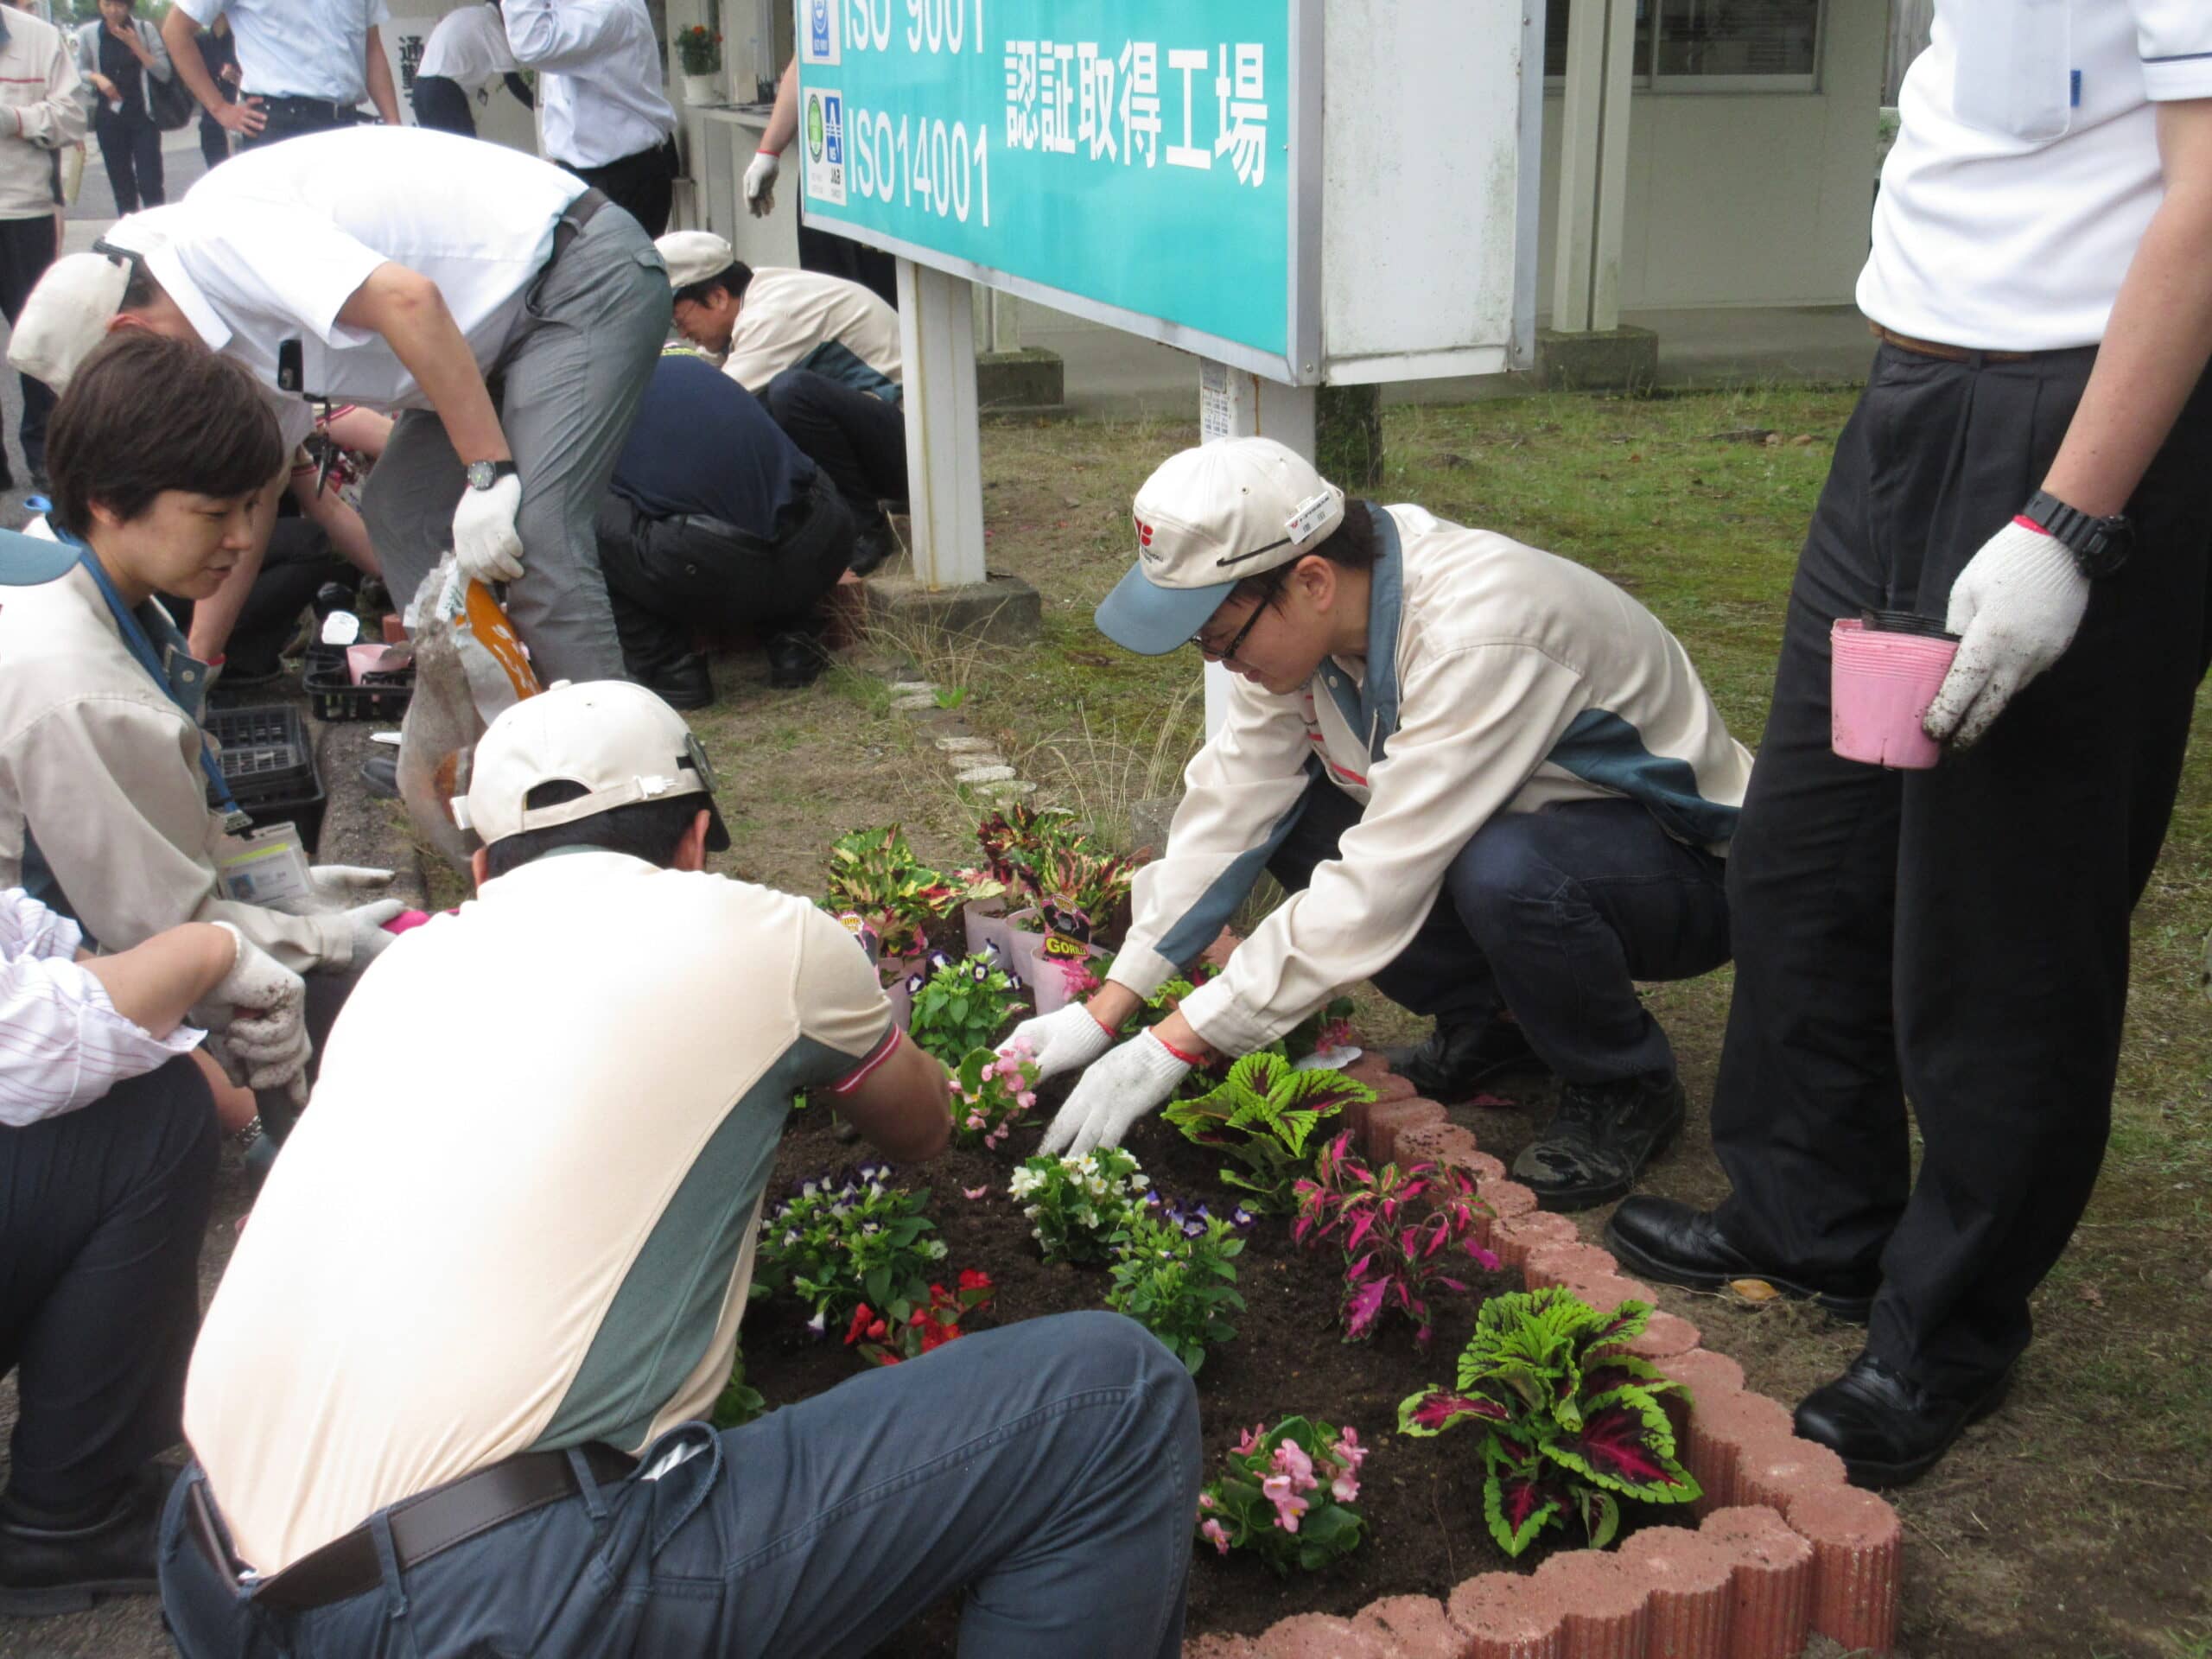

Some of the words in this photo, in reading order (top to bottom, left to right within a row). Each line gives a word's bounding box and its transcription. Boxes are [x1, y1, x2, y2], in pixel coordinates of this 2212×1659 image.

[844, 0, 891, 52] ISO
[906, 0, 983, 54] 9001
[848, 108, 988, 227] ISO14001
[1004, 39, 1268, 188] 認証取得工場
